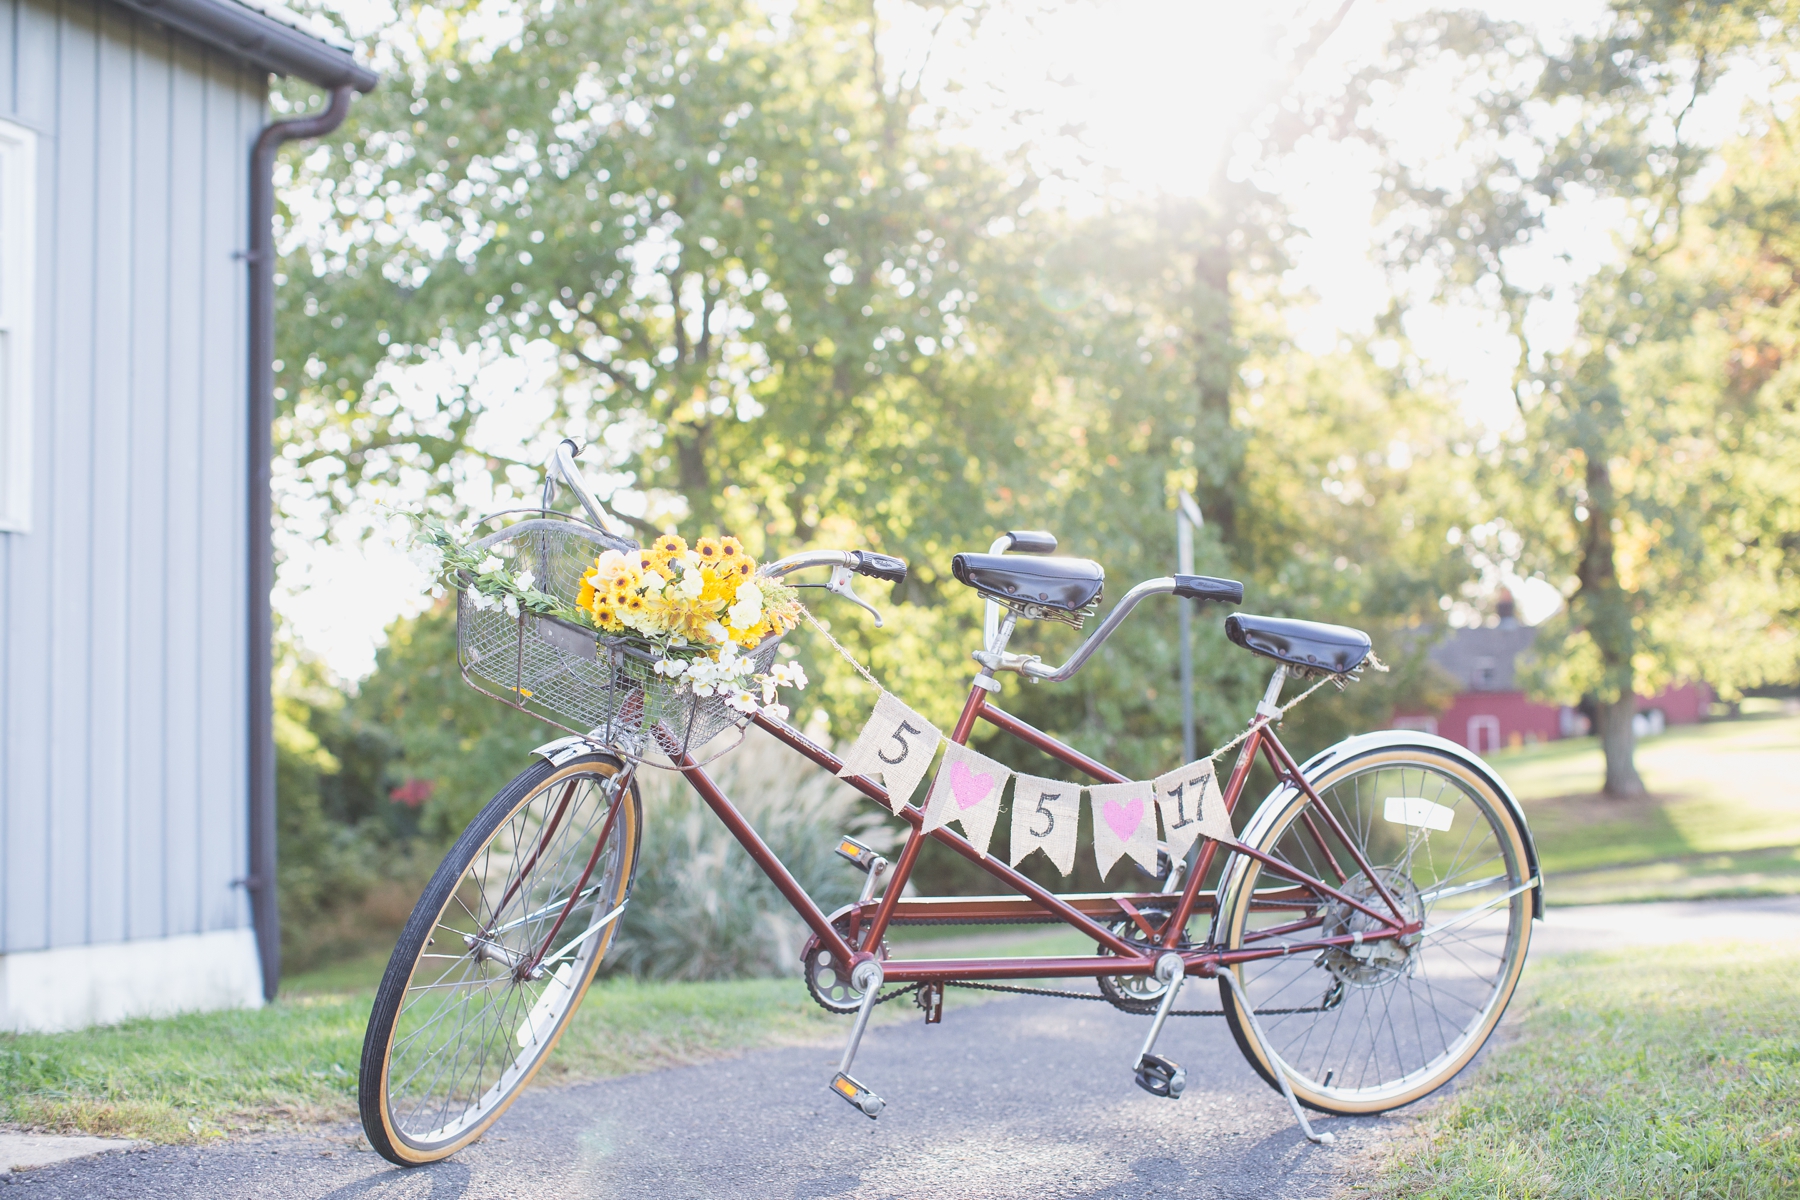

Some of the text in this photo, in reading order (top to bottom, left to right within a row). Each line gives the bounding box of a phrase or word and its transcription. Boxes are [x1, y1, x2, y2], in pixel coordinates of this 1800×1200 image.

[878, 720, 1210, 837] 5 5 17
